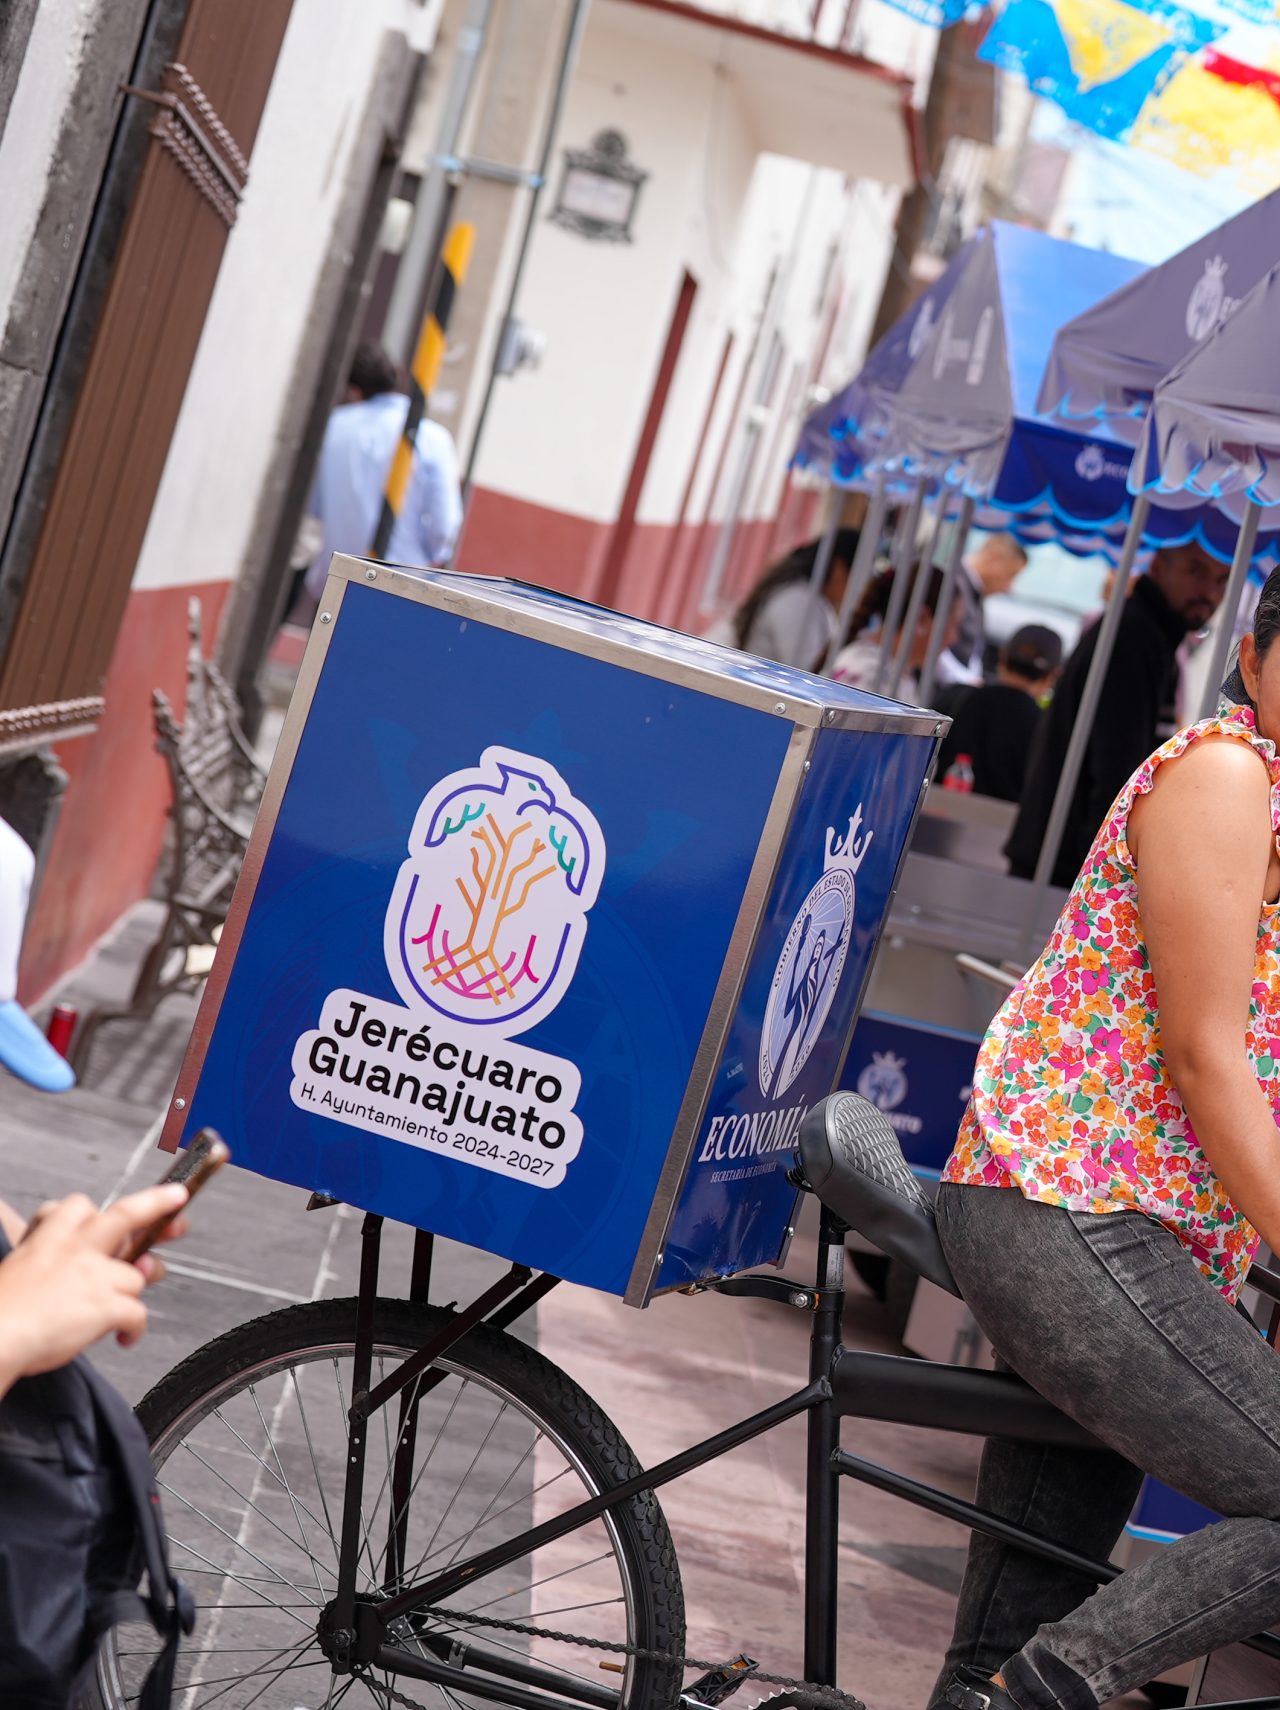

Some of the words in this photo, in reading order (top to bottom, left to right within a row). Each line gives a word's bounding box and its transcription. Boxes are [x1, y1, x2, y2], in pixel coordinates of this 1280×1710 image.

[308, 1036, 566, 1150] Guanajuato
[333, 1000, 563, 1104] Jerécuaro
[300, 1082, 317, 1102] H.
[320, 1090, 448, 1144] Ayuntamiento
[452, 1133, 554, 1177] 2024-2027
